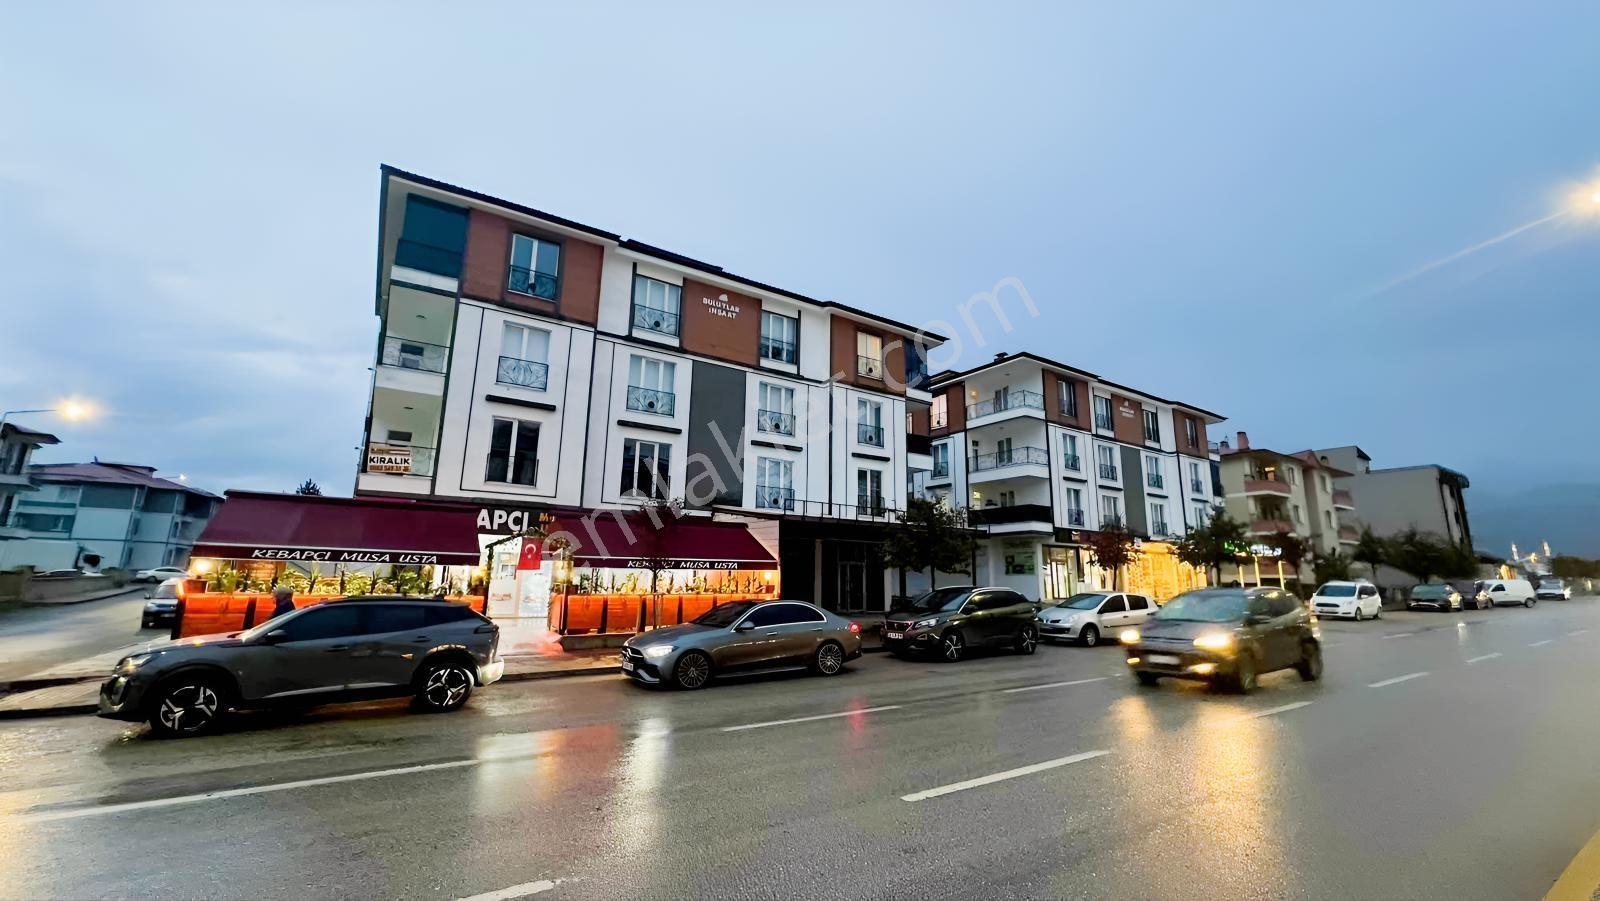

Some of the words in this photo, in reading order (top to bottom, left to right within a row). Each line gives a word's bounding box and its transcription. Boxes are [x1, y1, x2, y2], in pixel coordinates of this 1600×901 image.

[252, 549, 331, 561] KEBAPÇI
[340, 552, 391, 562] MUSA
[399, 554, 437, 564] USTA
[680, 561, 710, 569] MUSA
